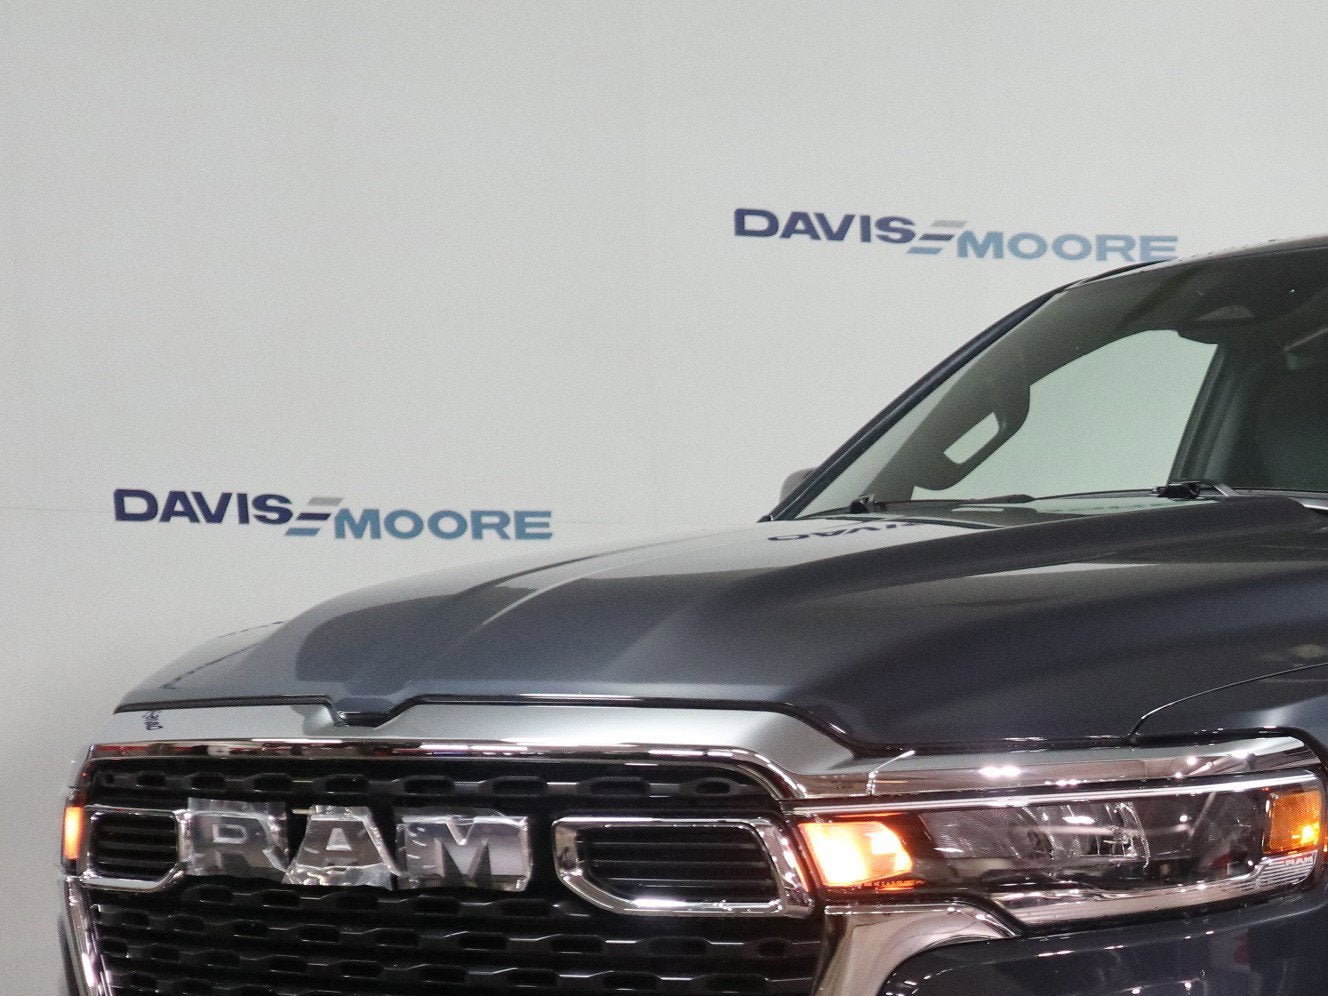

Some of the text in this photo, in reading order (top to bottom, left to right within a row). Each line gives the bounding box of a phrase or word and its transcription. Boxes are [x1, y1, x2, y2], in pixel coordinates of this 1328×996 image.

[733, 208, 1178, 262] DAVIS MOORE
[113, 488, 553, 540] DAVIS MOORE
[180, 806, 532, 892] RAM
